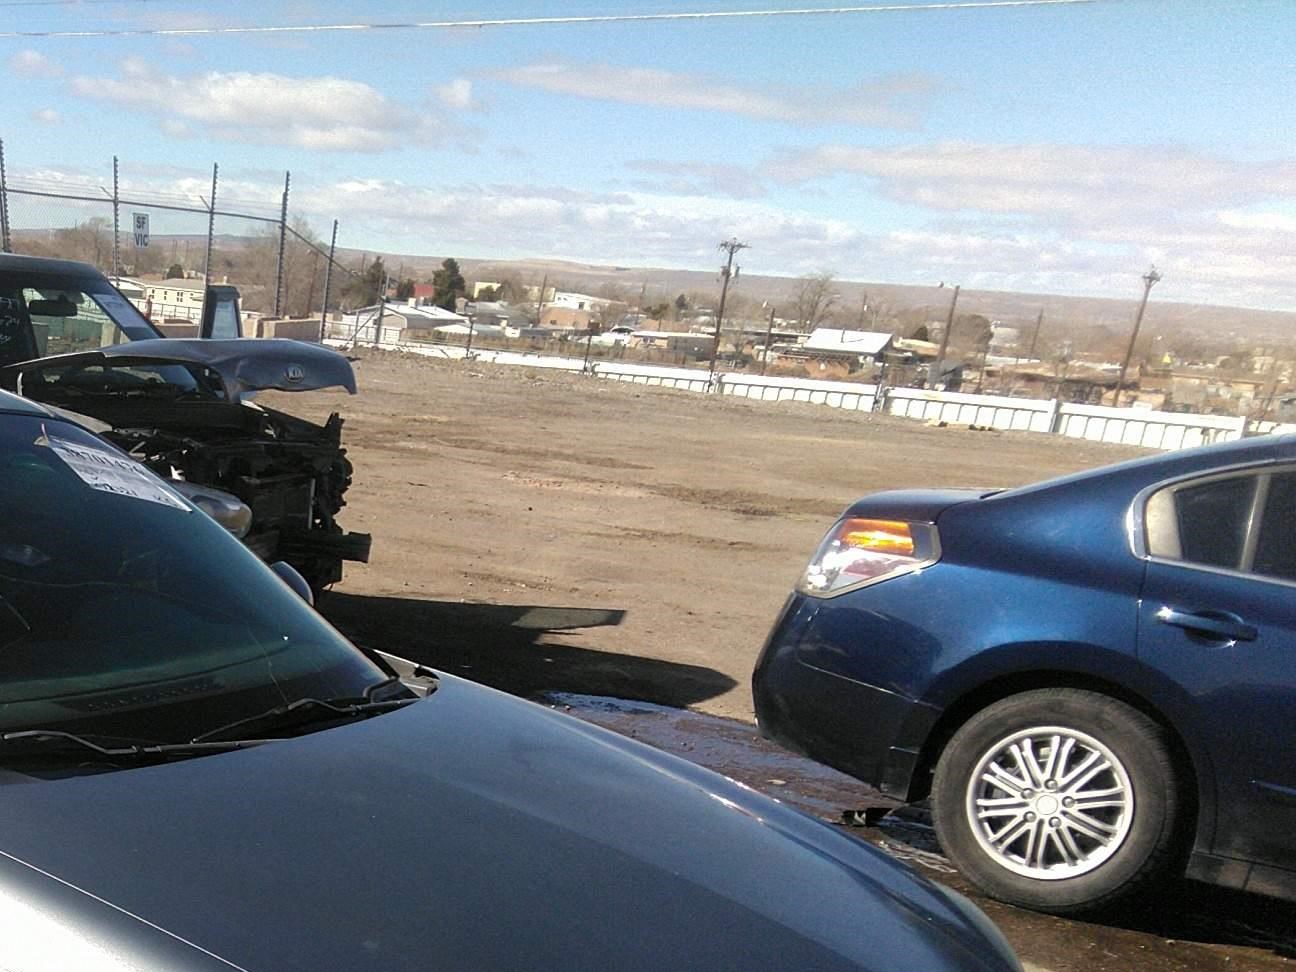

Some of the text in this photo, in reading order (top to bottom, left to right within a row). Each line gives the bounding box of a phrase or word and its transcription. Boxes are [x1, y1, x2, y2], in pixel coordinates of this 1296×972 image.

[136, 215, 147, 230] SF
[134, 233, 149, 247] VIC
[286, 366, 304, 379] KIA
